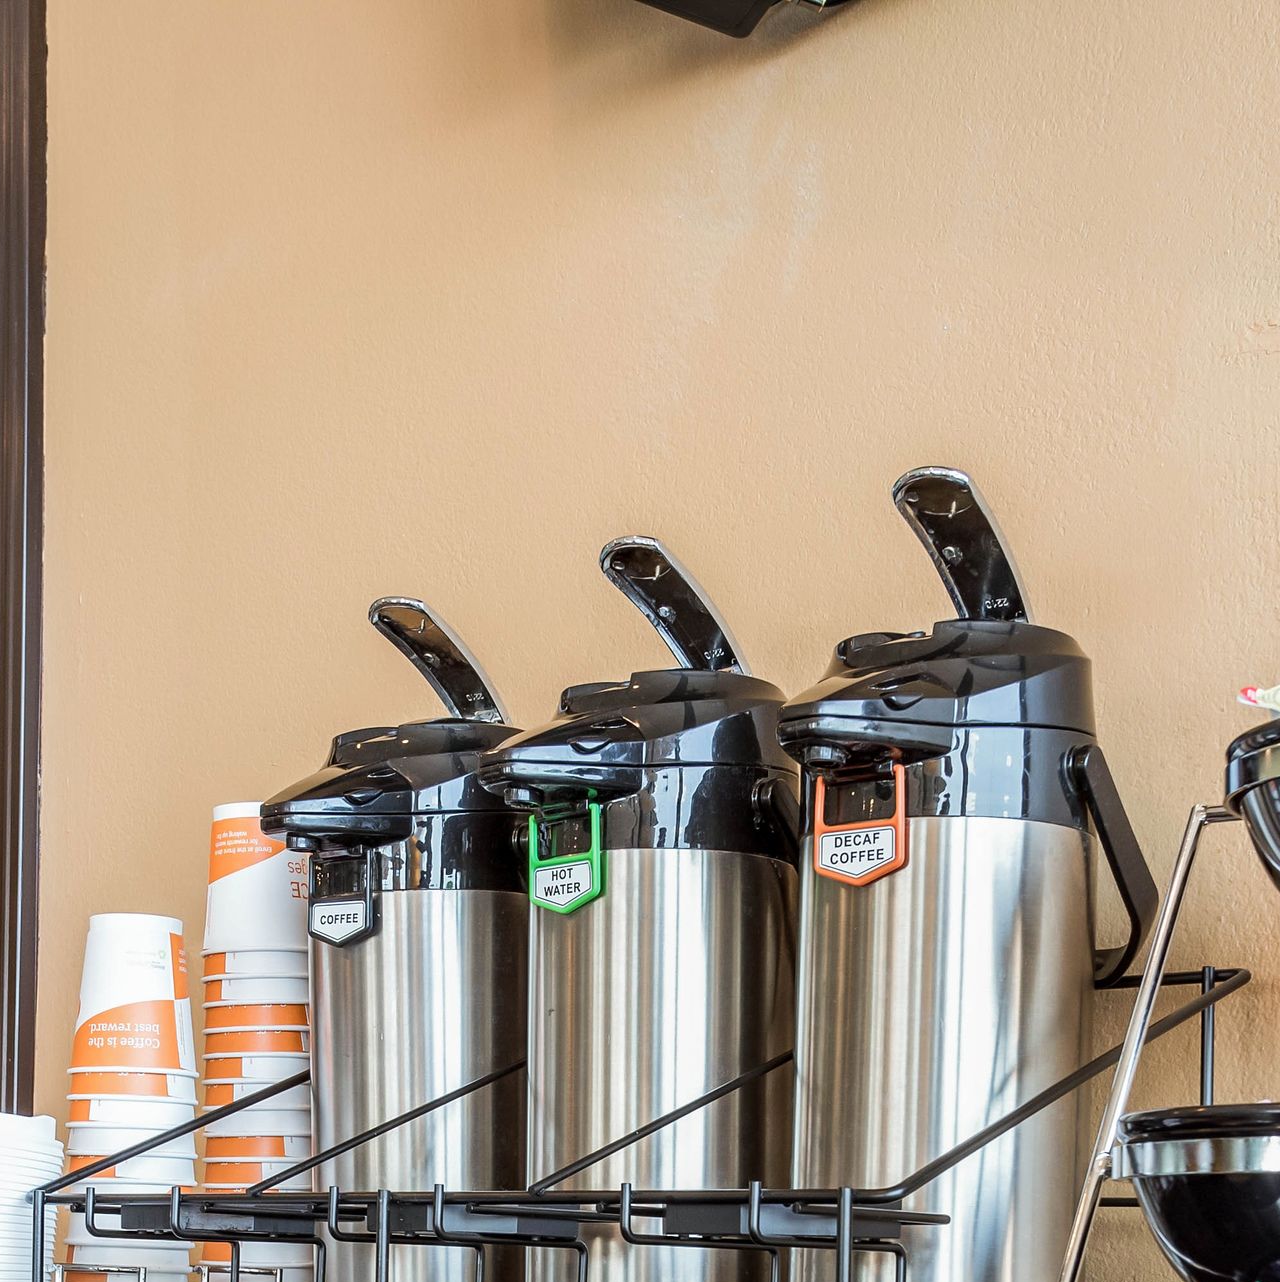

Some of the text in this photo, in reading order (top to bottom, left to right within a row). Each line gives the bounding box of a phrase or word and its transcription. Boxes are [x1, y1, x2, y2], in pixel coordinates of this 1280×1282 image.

[834, 832, 880, 848] DECAF
[830, 848, 884, 865] COFFEE
[551, 868, 574, 881] HOT
[544, 882, 581, 897] WATER
[320, 913, 359, 925] COFFEE
[89, 1023, 160, 1034] best reward.
[88, 1037, 160, 1049] Coffee is the
